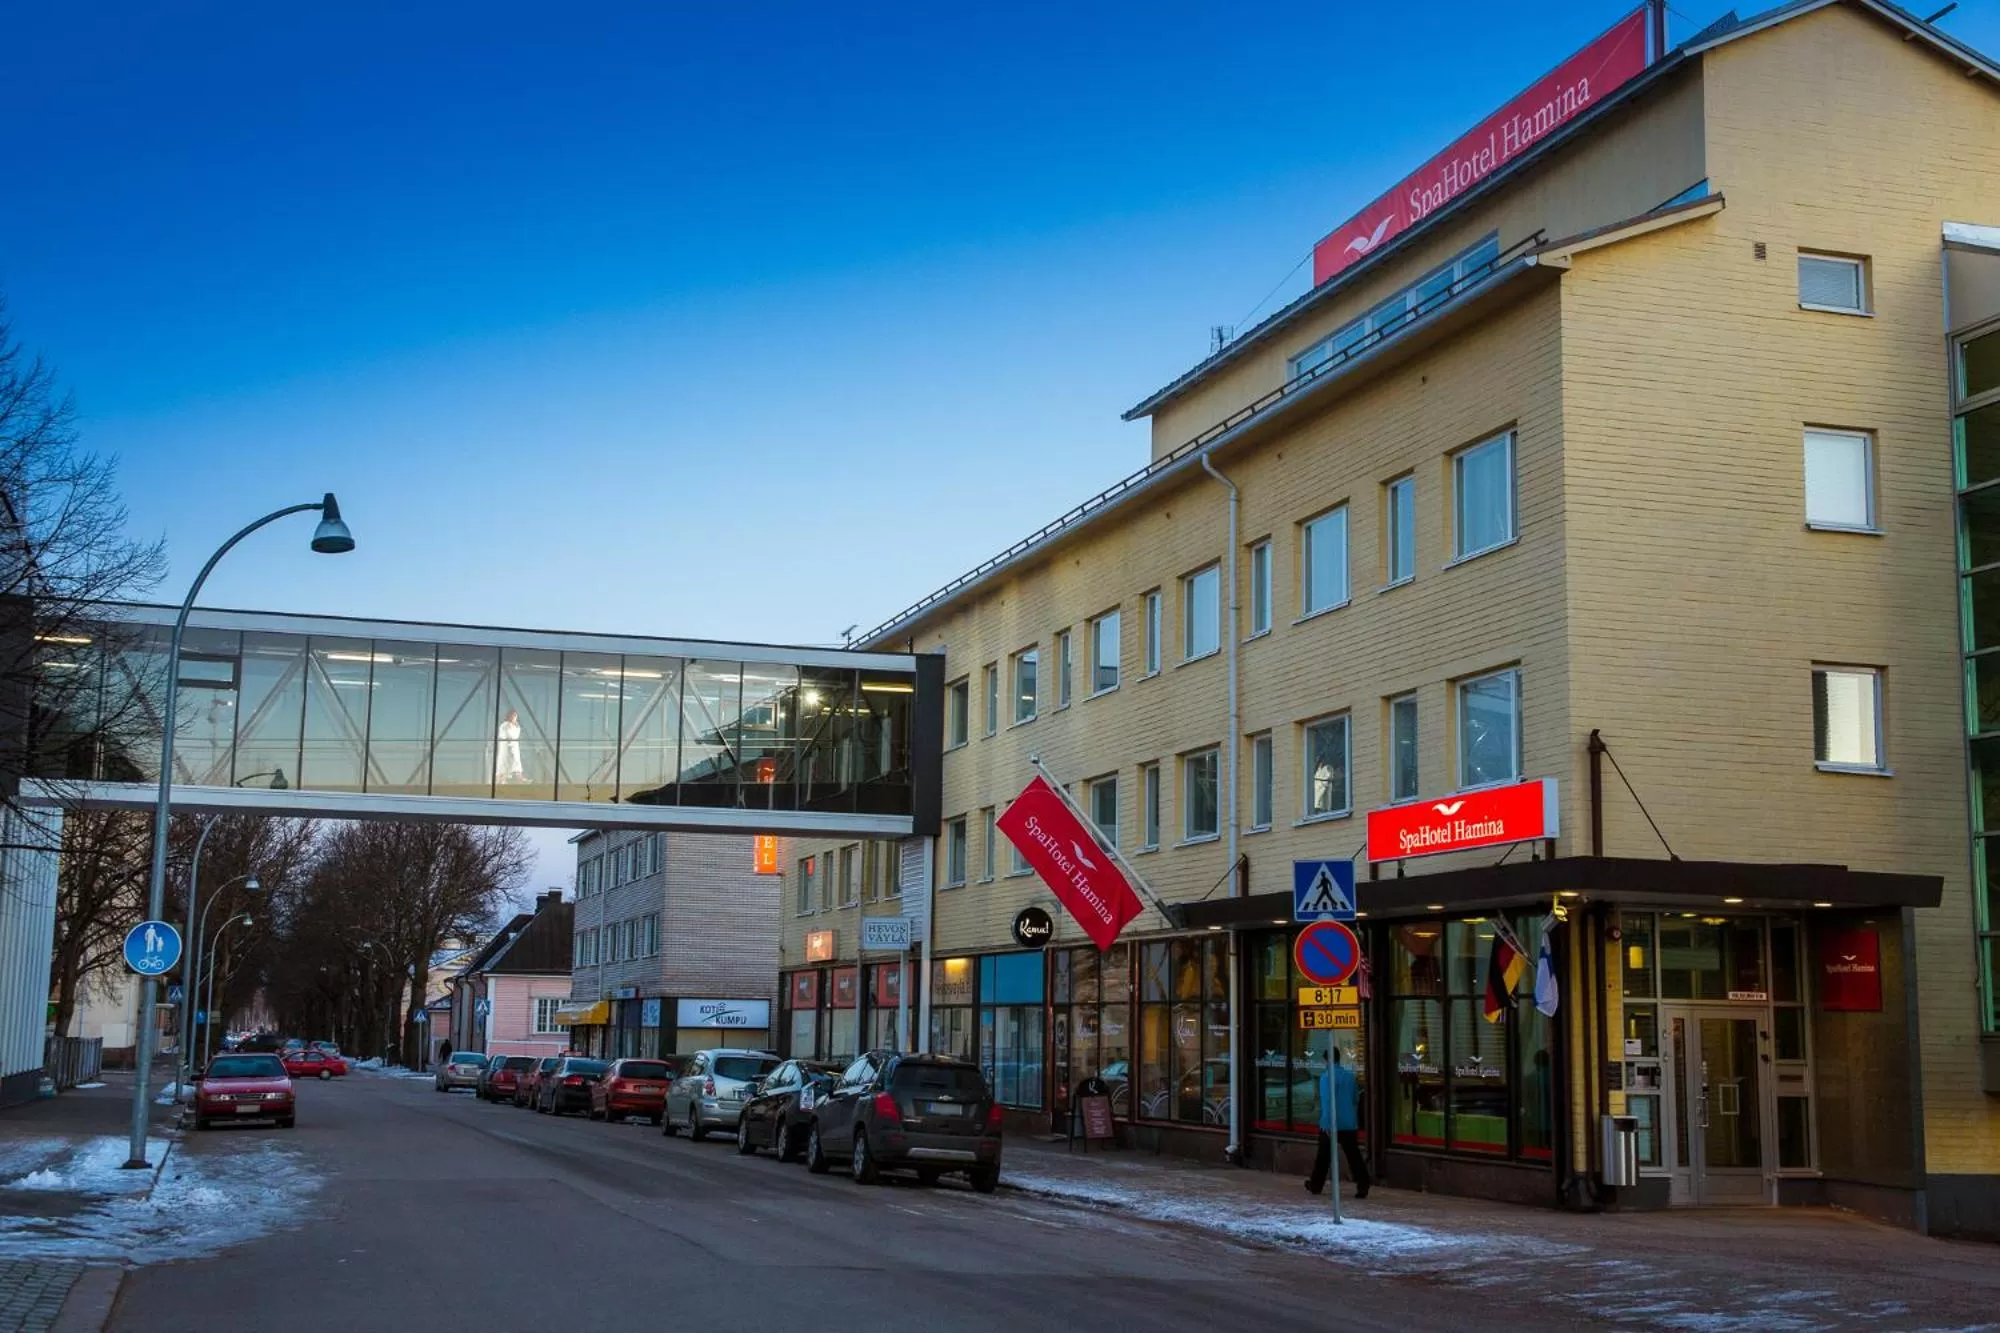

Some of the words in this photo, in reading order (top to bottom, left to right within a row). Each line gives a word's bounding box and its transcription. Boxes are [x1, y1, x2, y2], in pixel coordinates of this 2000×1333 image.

[1409, 132, 1496, 222] SpaHotel
[1501, 77, 1591, 159] Hamina
[1400, 823, 1451, 853] SpaHotel
[1455, 815, 1504, 841] Hamina
[1024, 816, 1076, 877] SpaHotel
[1072, 871, 1114, 925] Hamina
[868, 924, 906, 933] HEVOS
[1315, 988, 1342, 1003] 8-17
[715, 1016, 747, 1025] KUMPU
[1317, 1013, 1333, 1025] 30
[1335, 1013, 1357, 1025] min
